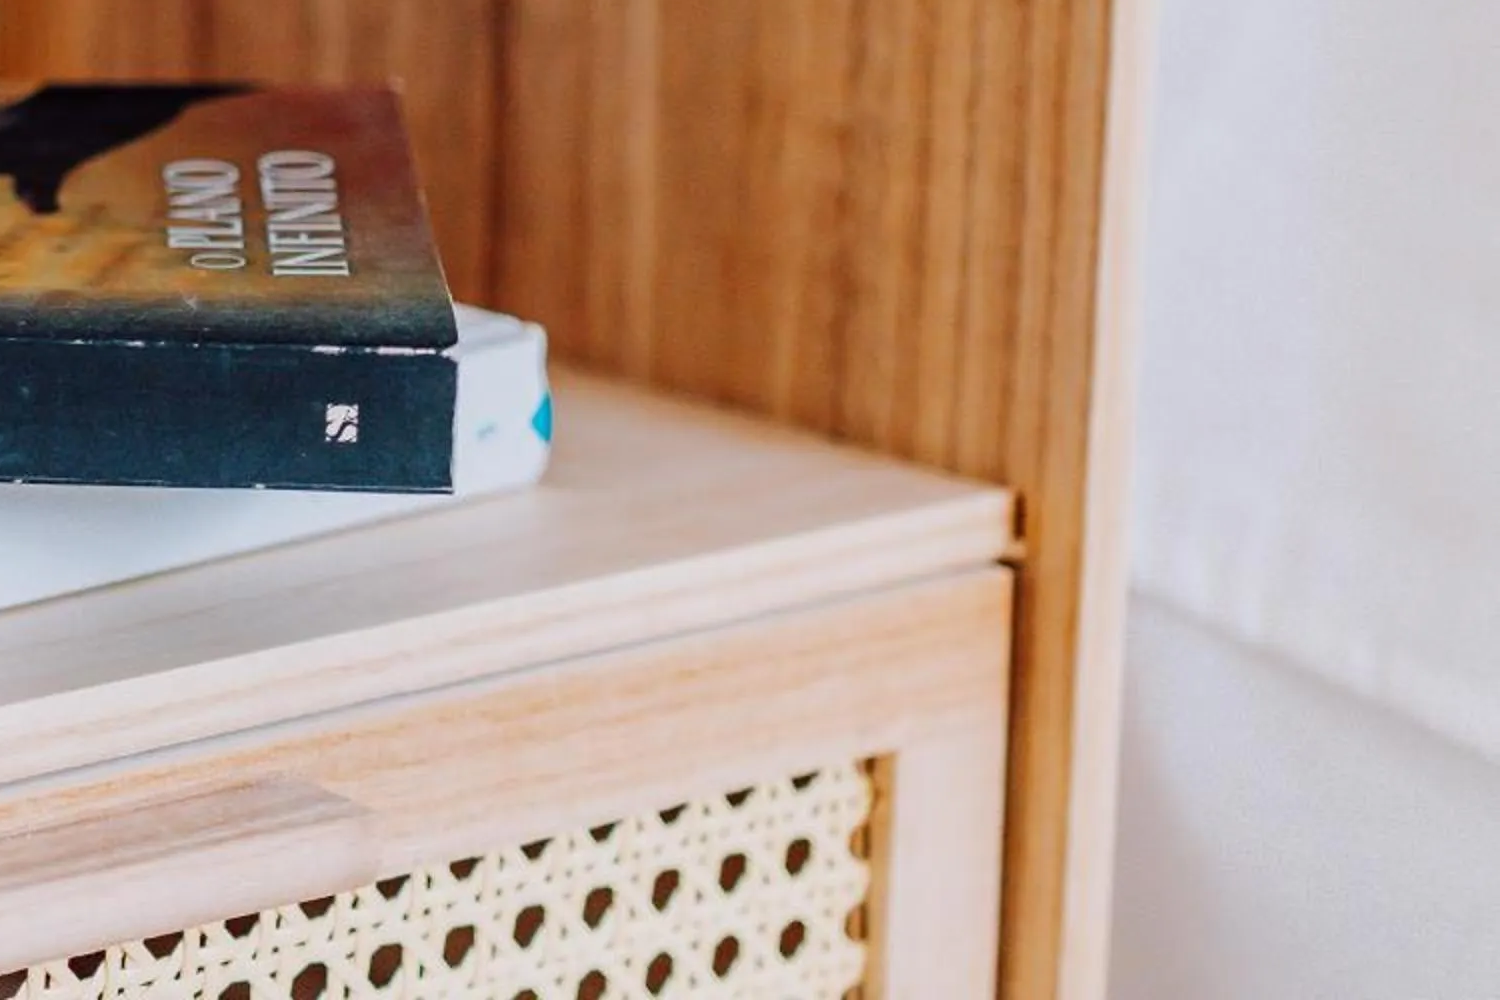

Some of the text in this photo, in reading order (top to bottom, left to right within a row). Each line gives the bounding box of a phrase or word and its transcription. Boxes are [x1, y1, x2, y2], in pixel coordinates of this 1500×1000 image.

[162, 157, 247, 270] O PLANO
[256, 149, 350, 277] INFINITO
